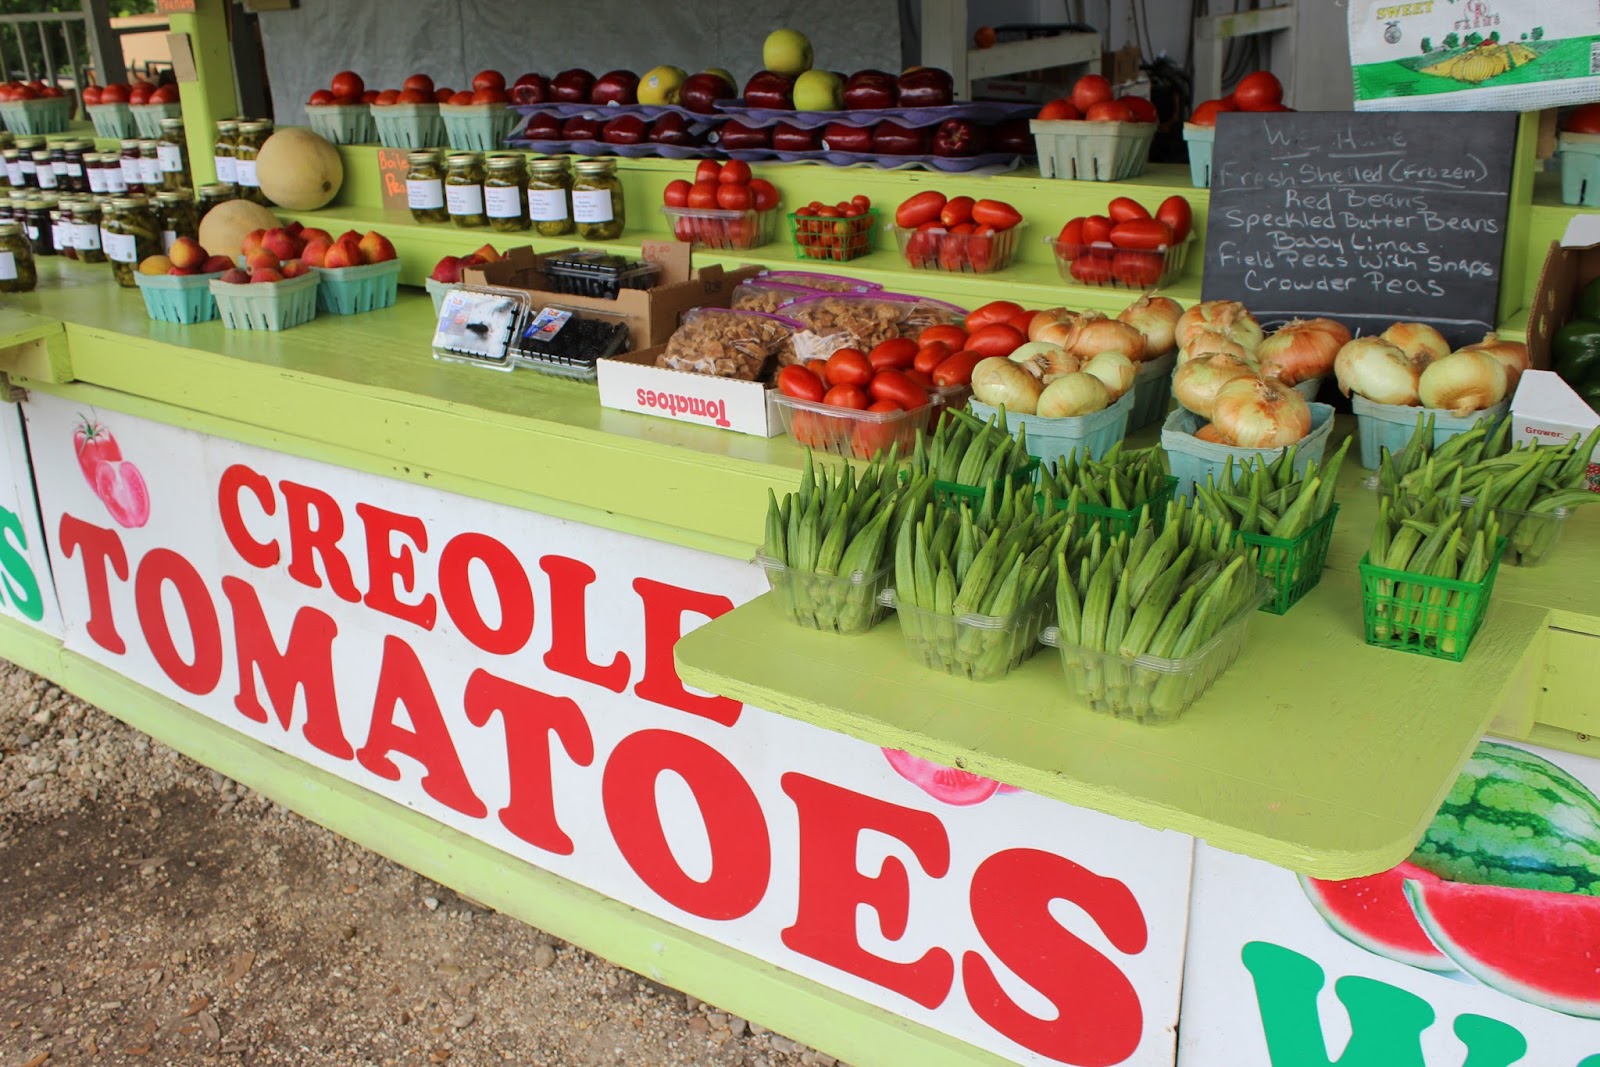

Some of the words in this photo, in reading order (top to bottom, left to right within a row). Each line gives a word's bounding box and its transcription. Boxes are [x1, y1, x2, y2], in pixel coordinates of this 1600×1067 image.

[1376, 0, 1434, 20] SWEET
[1285, 188, 1332, 210] Red
[1338, 187, 1429, 211] Beans
[1225, 209, 1336, 233] Speckled
[1339, 211, 1417, 230] Butter
[1416, 209, 1500, 233] Beans
[1266, 230, 1345, 254] Baby
[1351, 232, 1430, 255] Limas
[1219, 240, 1275, 269] Field
[1277, 249, 1349, 269] Peas
[1428, 254, 1495, 279] Snaps
[1244, 269, 1357, 291] Crowder
[1363, 271, 1446, 297] Peas
[636, 388, 731, 428] Tomatoes
[1525, 426, 1564, 439] Grower:
[59, 511, 1149, 1067] TOMATOES
